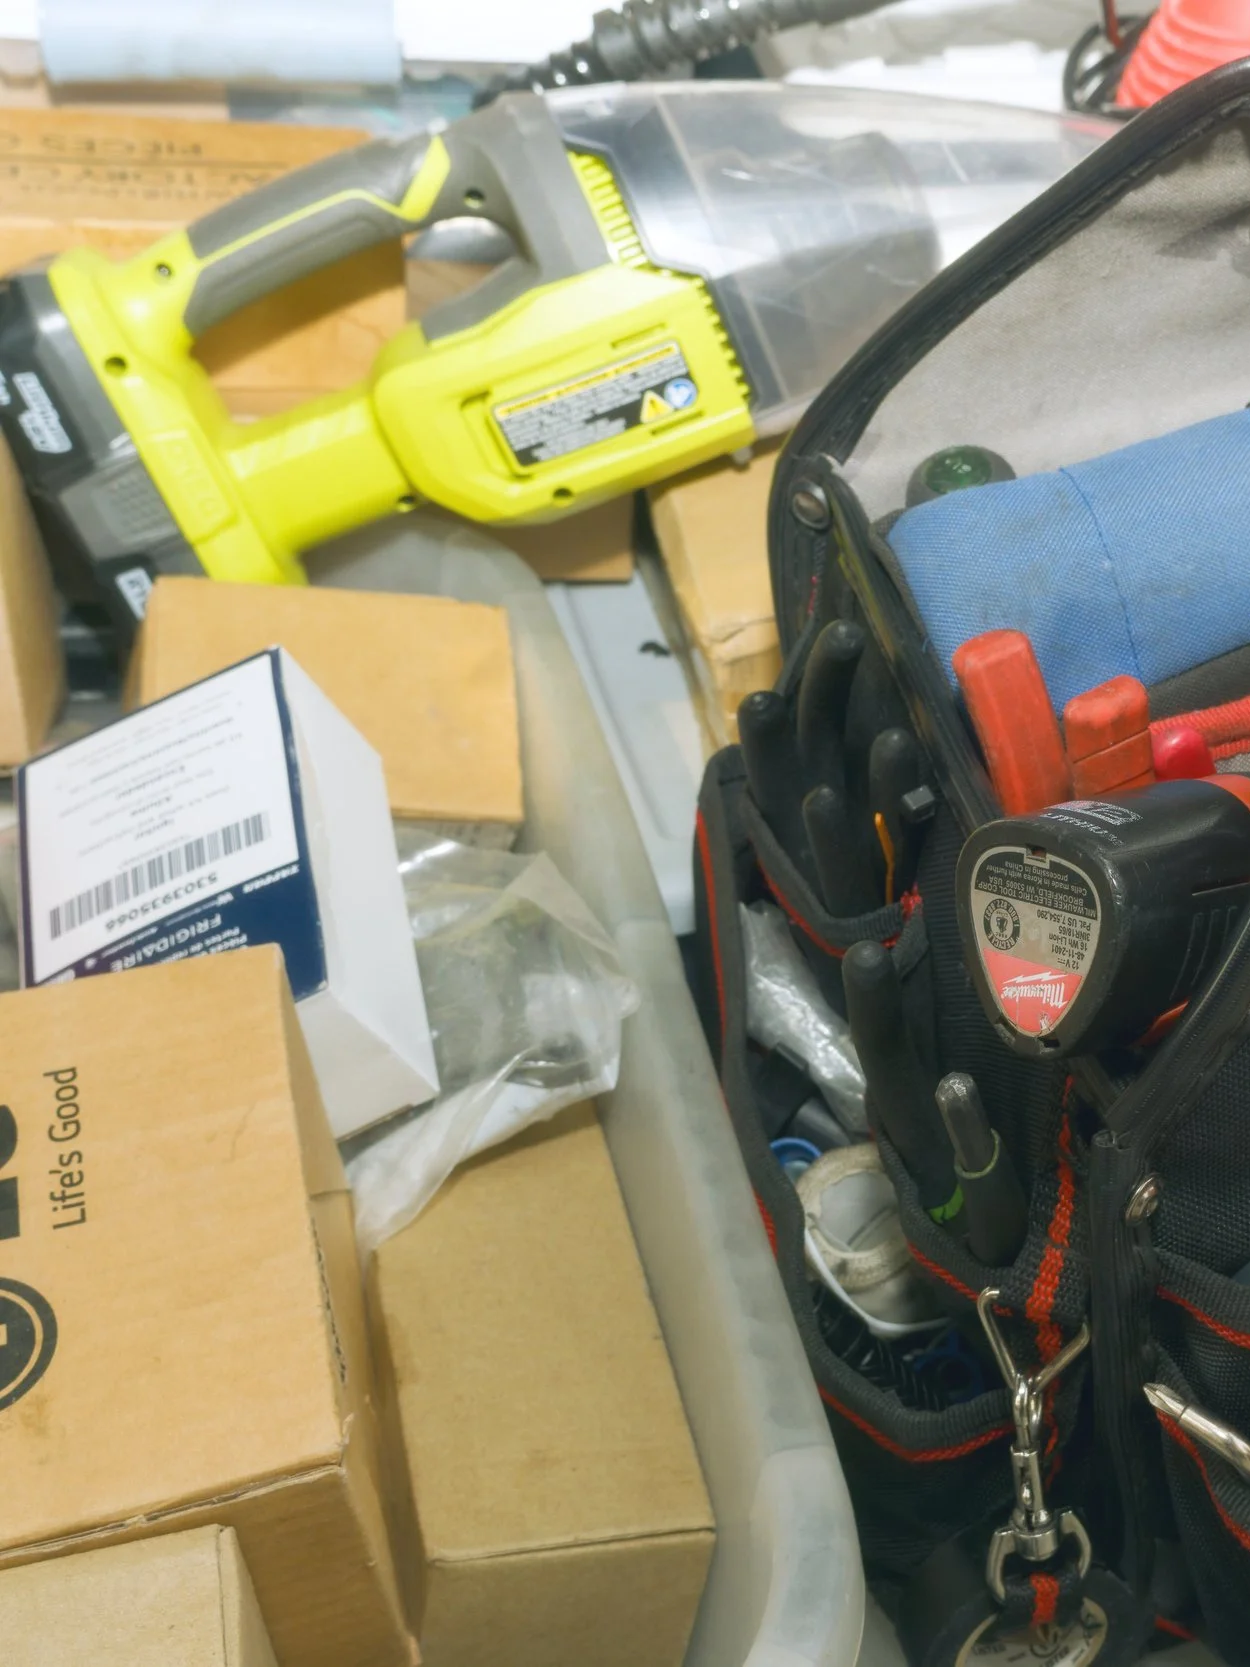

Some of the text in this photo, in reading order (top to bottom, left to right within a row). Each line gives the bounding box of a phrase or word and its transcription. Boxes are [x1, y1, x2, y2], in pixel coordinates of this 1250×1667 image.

[986, 864, 1008, 877] further
[1004, 860, 1024, 872] China
[988, 874, 1004, 886] USA
[1008, 868, 1022, 880] with
[1023, 873, 1043, 885] Korea
[1032, 866, 1069, 882] processing
[1001, 885, 1019, 898] TOOL
[1026, 883, 1035, 894] WI
[1051, 880, 1070, 891] made
[1070, 885, 1088, 896] Cells
[105, 872, 219, 933] 5303935066
[1019, 890, 1053, 907] ELECTRIC
[1053, 898, 1097, 919] MILWAUKEE
[1067, 916, 1078, 927] US
[110, 913, 222, 973] FRIGIDAIRE
[1066, 938, 1079, 950] Wh
[1080, 942, 1088, 952] 16
[1051, 944, 1085, 961] 48-11-2401
[1071, 962, 1080, 970] 12
[1001, 982, 1068, 1009] Milwaukee
[43, 1066, 87, 1230] Life's Good
